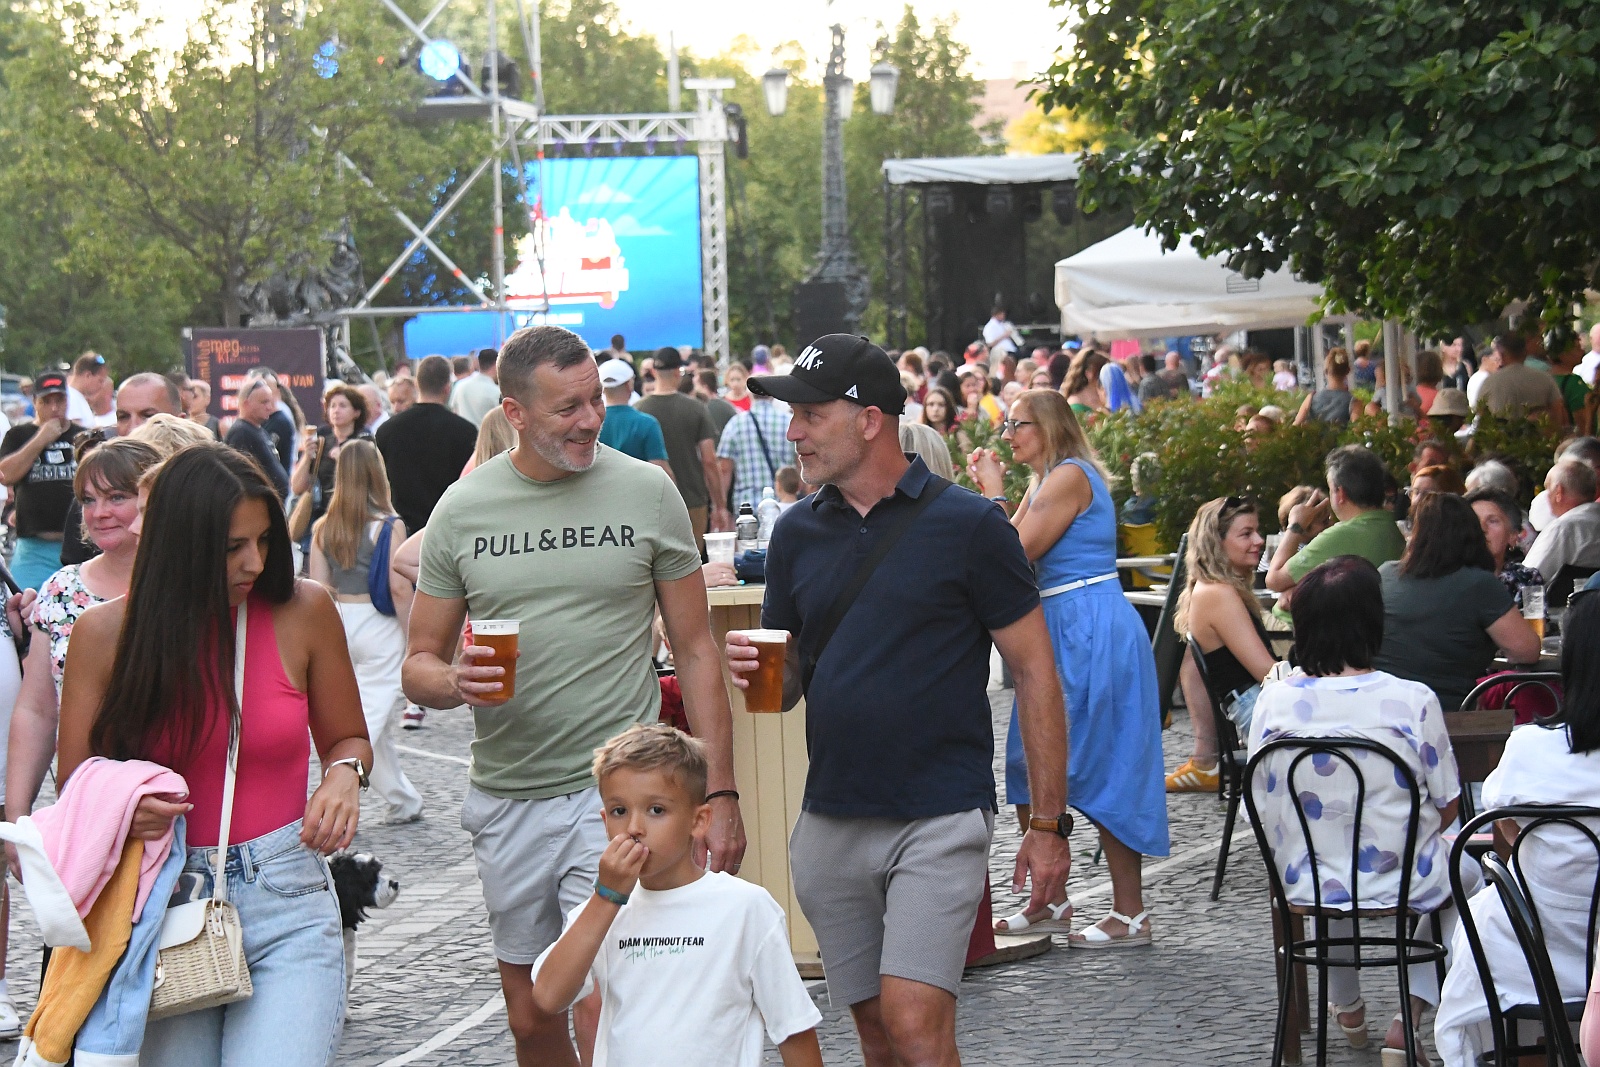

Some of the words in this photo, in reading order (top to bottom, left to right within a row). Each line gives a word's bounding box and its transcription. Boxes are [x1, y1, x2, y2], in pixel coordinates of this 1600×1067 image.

[473, 524, 636, 560] PULL&BEAR
[642, 937, 681, 946] WITHOUT
[682, 937, 704, 946] FEAR
